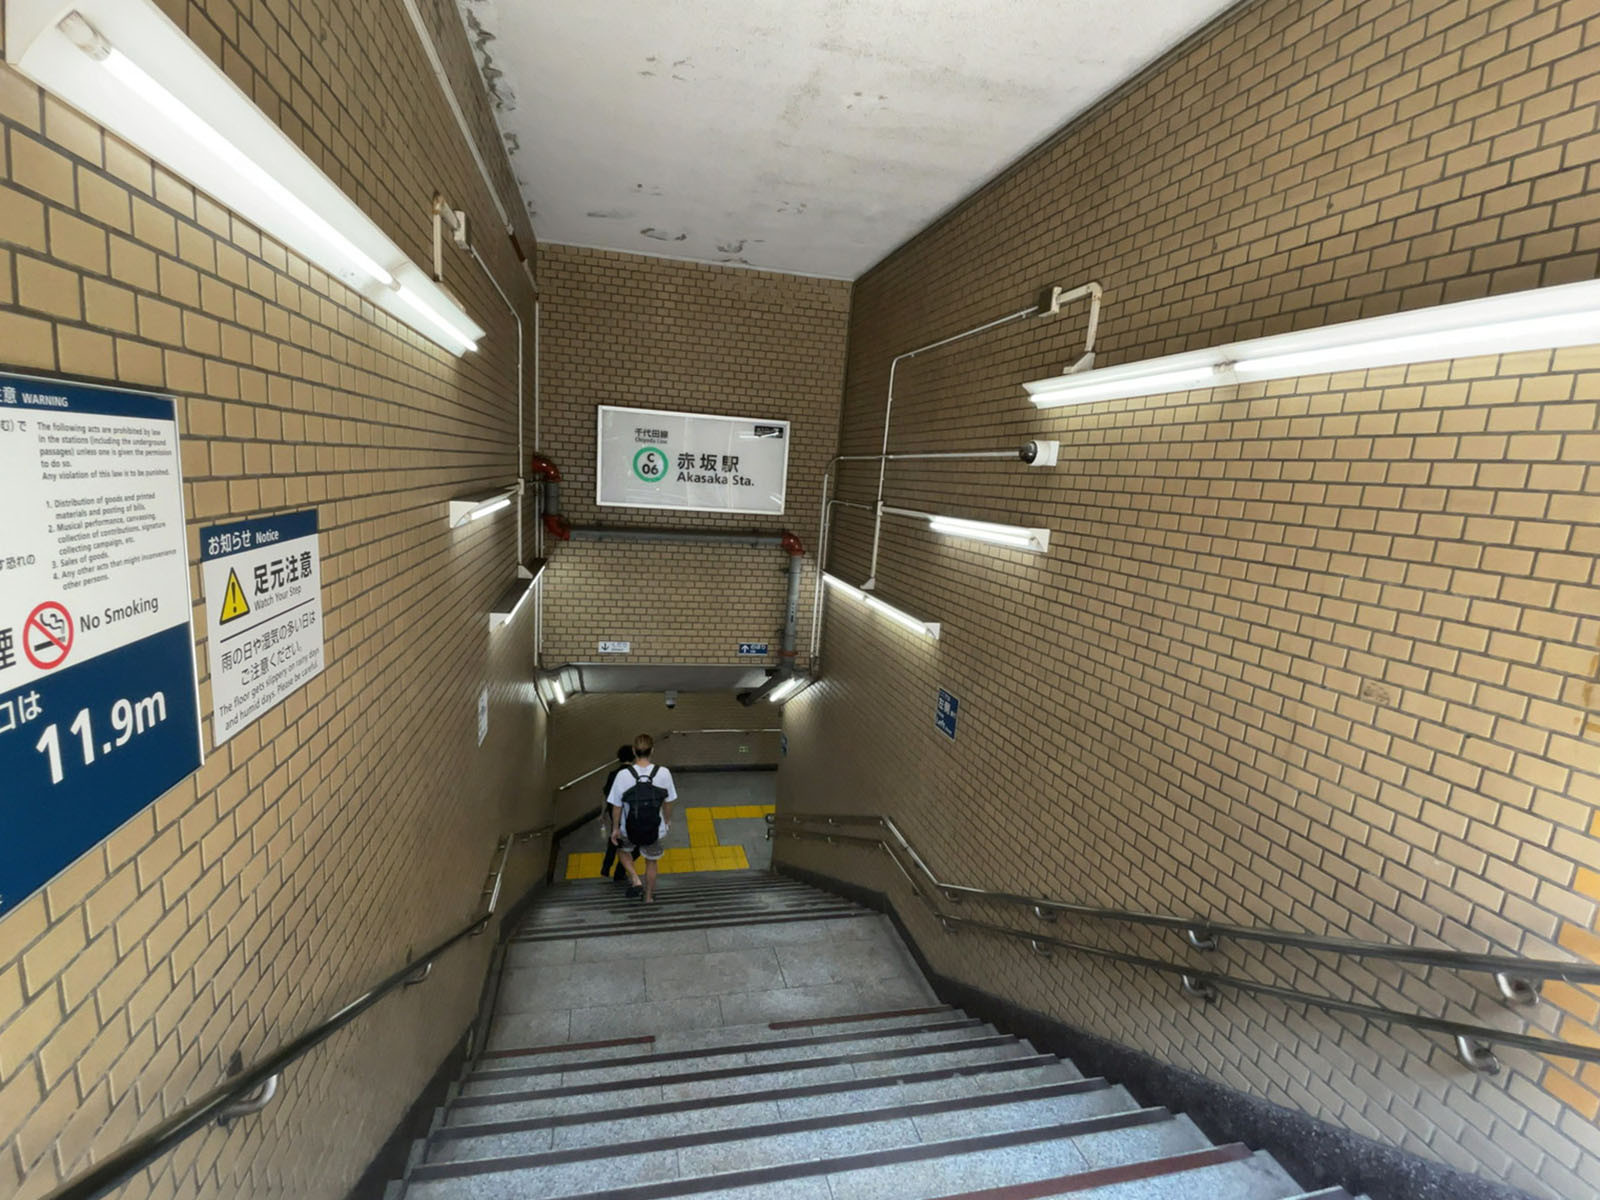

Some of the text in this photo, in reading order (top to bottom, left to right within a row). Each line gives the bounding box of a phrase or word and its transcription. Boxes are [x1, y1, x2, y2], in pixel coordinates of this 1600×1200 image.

[0, 386, 17, 404] 意
[22, 393, 69, 407] WARNING
[634, 428, 669, 439] 千代田線
[642, 463, 659, 475] 06
[647, 453, 655, 463] C
[677, 452, 740, 473] 赤坂駅
[676, 471, 755, 487] Akasaka Sta.
[208, 529, 279, 555] お知らせ Notice
[254, 551, 312, 597] 足元注意
[254, 585, 302, 611] Watch Your Step
[80, 597, 159, 632] No Smoking
[221, 611, 316, 674] 雨の日や湿気の多い日は
[220, 647, 320, 717] The floor gets slippery on rainy days
[36, 691, 167, 785] 11.9m
